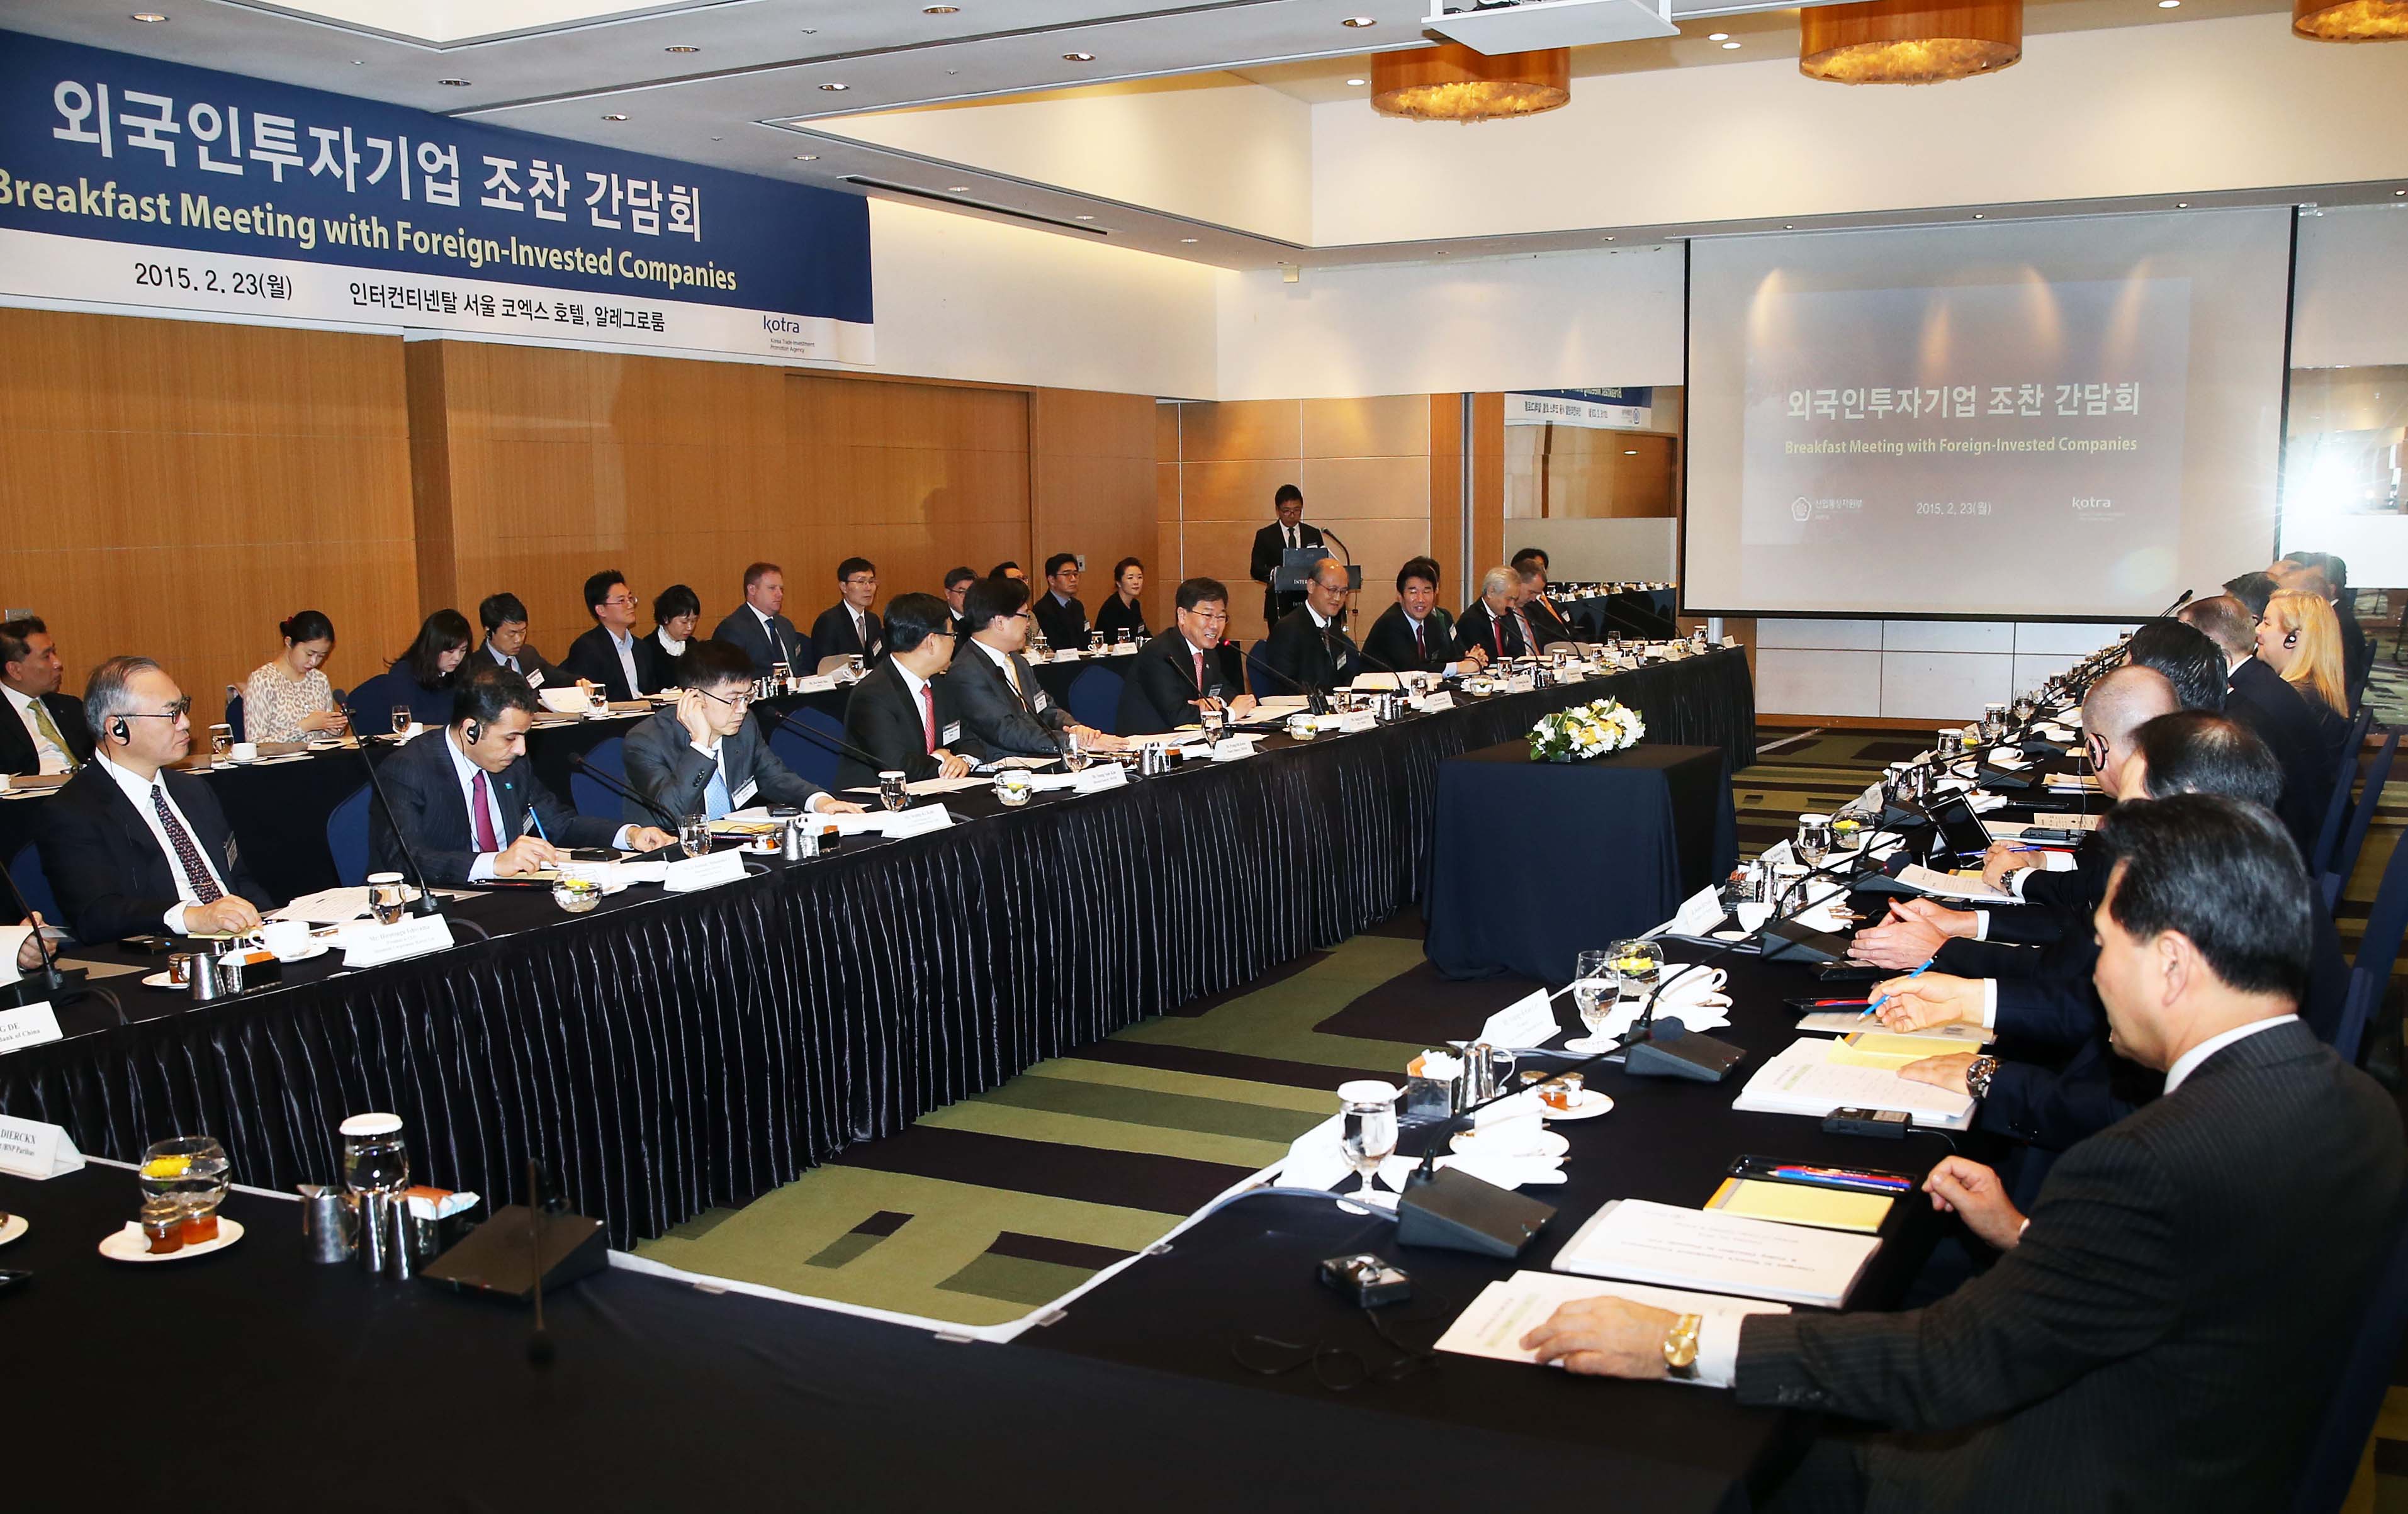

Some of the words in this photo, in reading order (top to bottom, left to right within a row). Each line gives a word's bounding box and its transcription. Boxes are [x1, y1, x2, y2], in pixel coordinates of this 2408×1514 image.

[53, 80, 461, 207] 외국인투자기업
[480, 154, 571, 222] 조찬
[584, 172, 702, 242] 간담회
[0, 167, 172, 225] Breakfast
[181, 194, 317, 249] Meeting
[325, 213, 390, 250] with
[397, 221, 614, 277] Foreign-Invested
[617, 250, 737, 291] Companies
[134, 262, 200, 291] 2015.
[205, 269, 227, 294] 2.
[232, 272, 293, 301] 23(월)
[349, 281, 458, 314] 인터컨티넨탈
[463, 293, 497, 317] 서울
[501, 297, 549, 321] 코엑스
[554, 301, 590, 328] 호텔,
[594, 306, 665, 332] 알레그로룸
[763, 315, 800, 334] kotra
[1786, 384, 1977, 420] 외국인투자기업
[1987, 383, 2044, 416] 조찬
[2053, 381, 2141, 416] 간담회
[1784, 439, 1847, 454] Breakfast
[1849, 438, 1904, 456] Meeting
[1906, 437, 1937, 452] with
[1939, 437, 2056, 456] Foreign-Invested
[2058, 435, 2137, 454] Companies
[1916, 503, 1945, 516] 2015.
[1960, 502, 1992, 516] 23(월)
[2071, 496, 2111, 510] kotra
